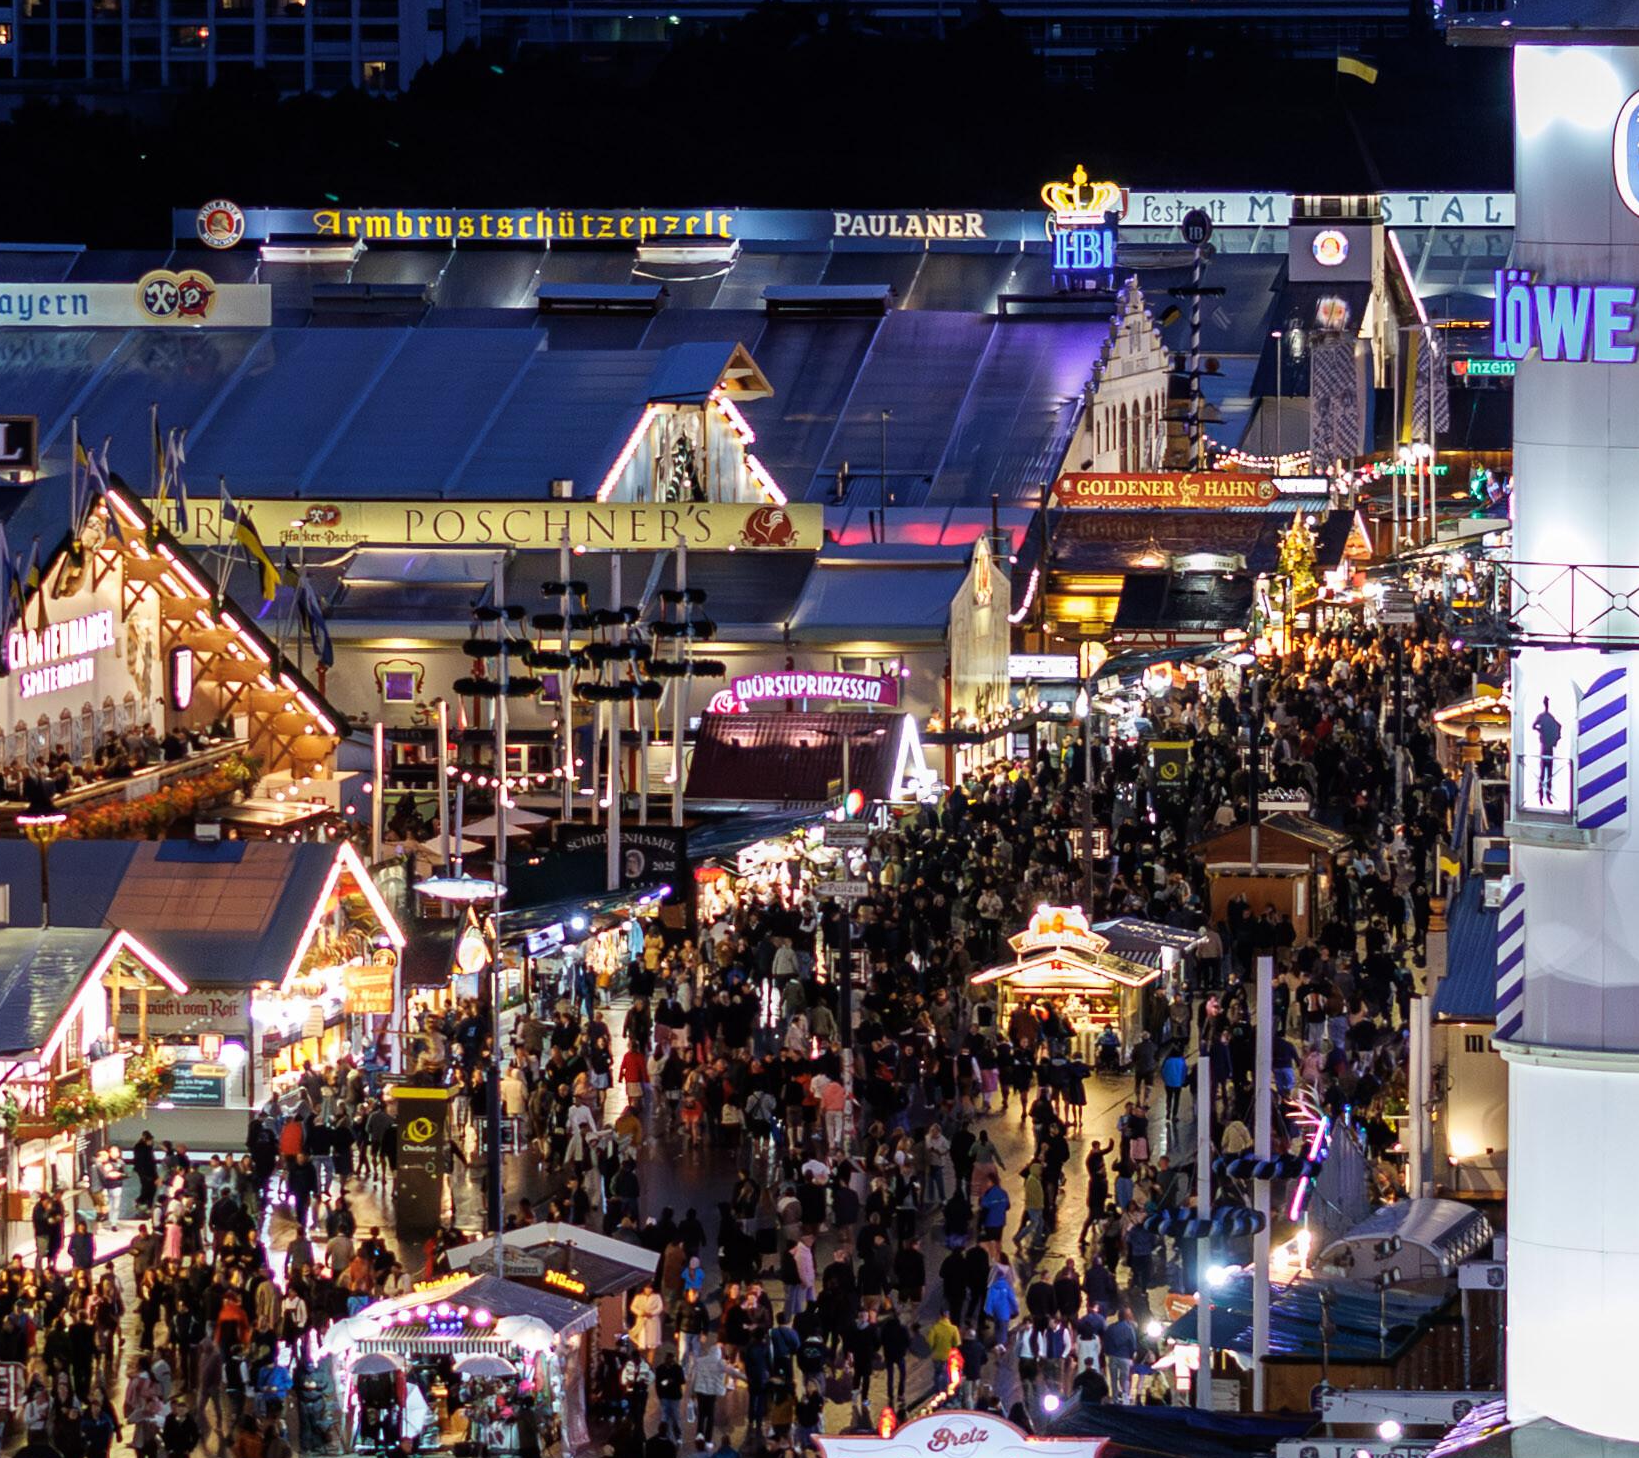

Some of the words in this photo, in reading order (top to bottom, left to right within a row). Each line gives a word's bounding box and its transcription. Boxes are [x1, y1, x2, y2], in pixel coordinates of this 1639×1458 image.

[313, 208, 733, 239] Armbrustschützenzelt
[1142, 196, 1227, 223] Festlt
[833, 212, 987, 239] PAULANER
[1076, 480, 1176, 497] GOLDENER
[1203, 480, 1256, 497] HAHN
[404, 506, 712, 543] POSCHNER'S
[736, 673, 882, 703] WÜRSTLPRINZESSIN
